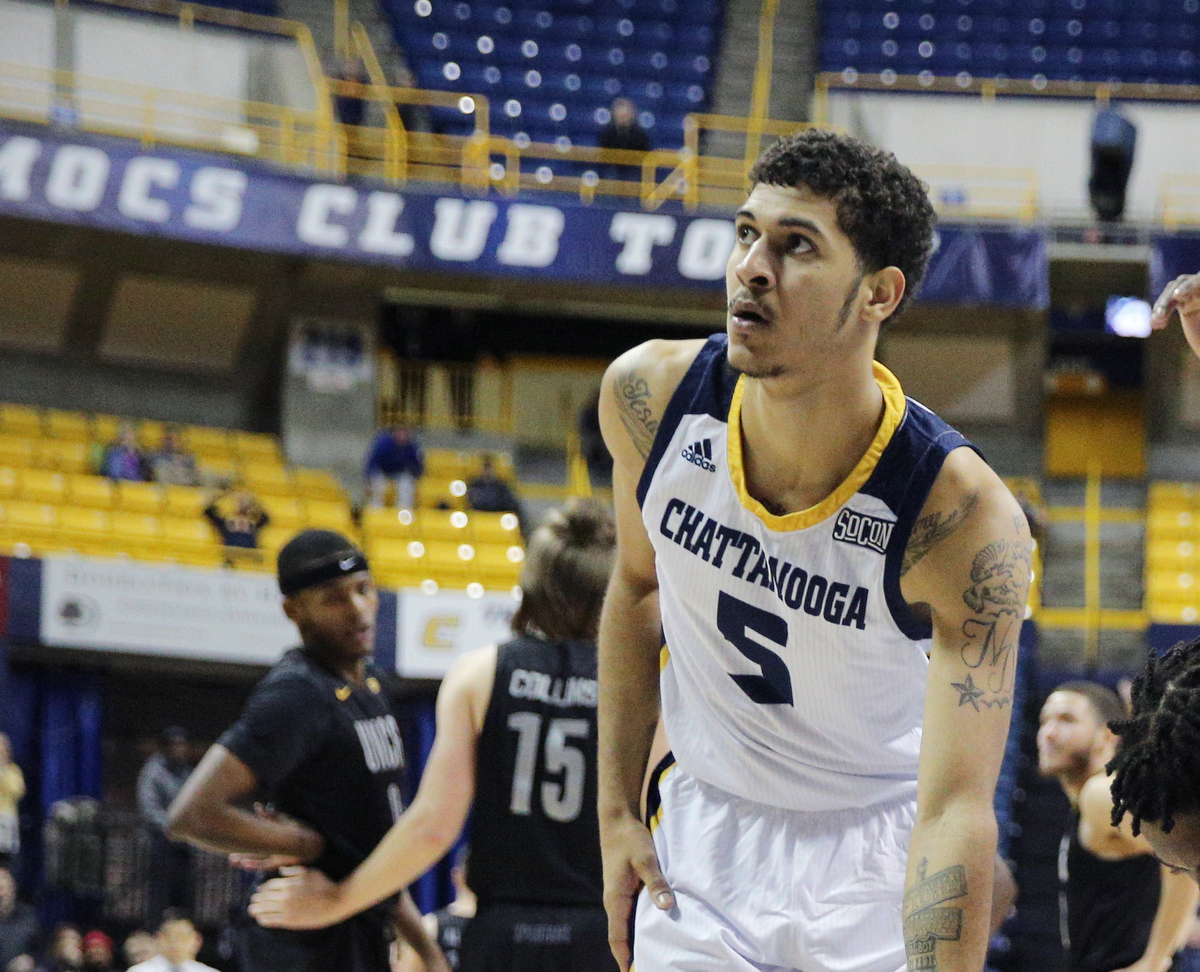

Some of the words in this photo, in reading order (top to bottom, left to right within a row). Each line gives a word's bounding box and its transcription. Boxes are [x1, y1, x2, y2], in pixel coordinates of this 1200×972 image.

[296, 183, 565, 268] CLUB
[609, 211, 736, 281] TO
[681, 448, 716, 473] adidas
[660, 498, 869, 630] CHATTANOOGA
[833, 509, 895, 554] SOCON
[717, 590, 794, 707] 5
[507, 711, 590, 823] 15
